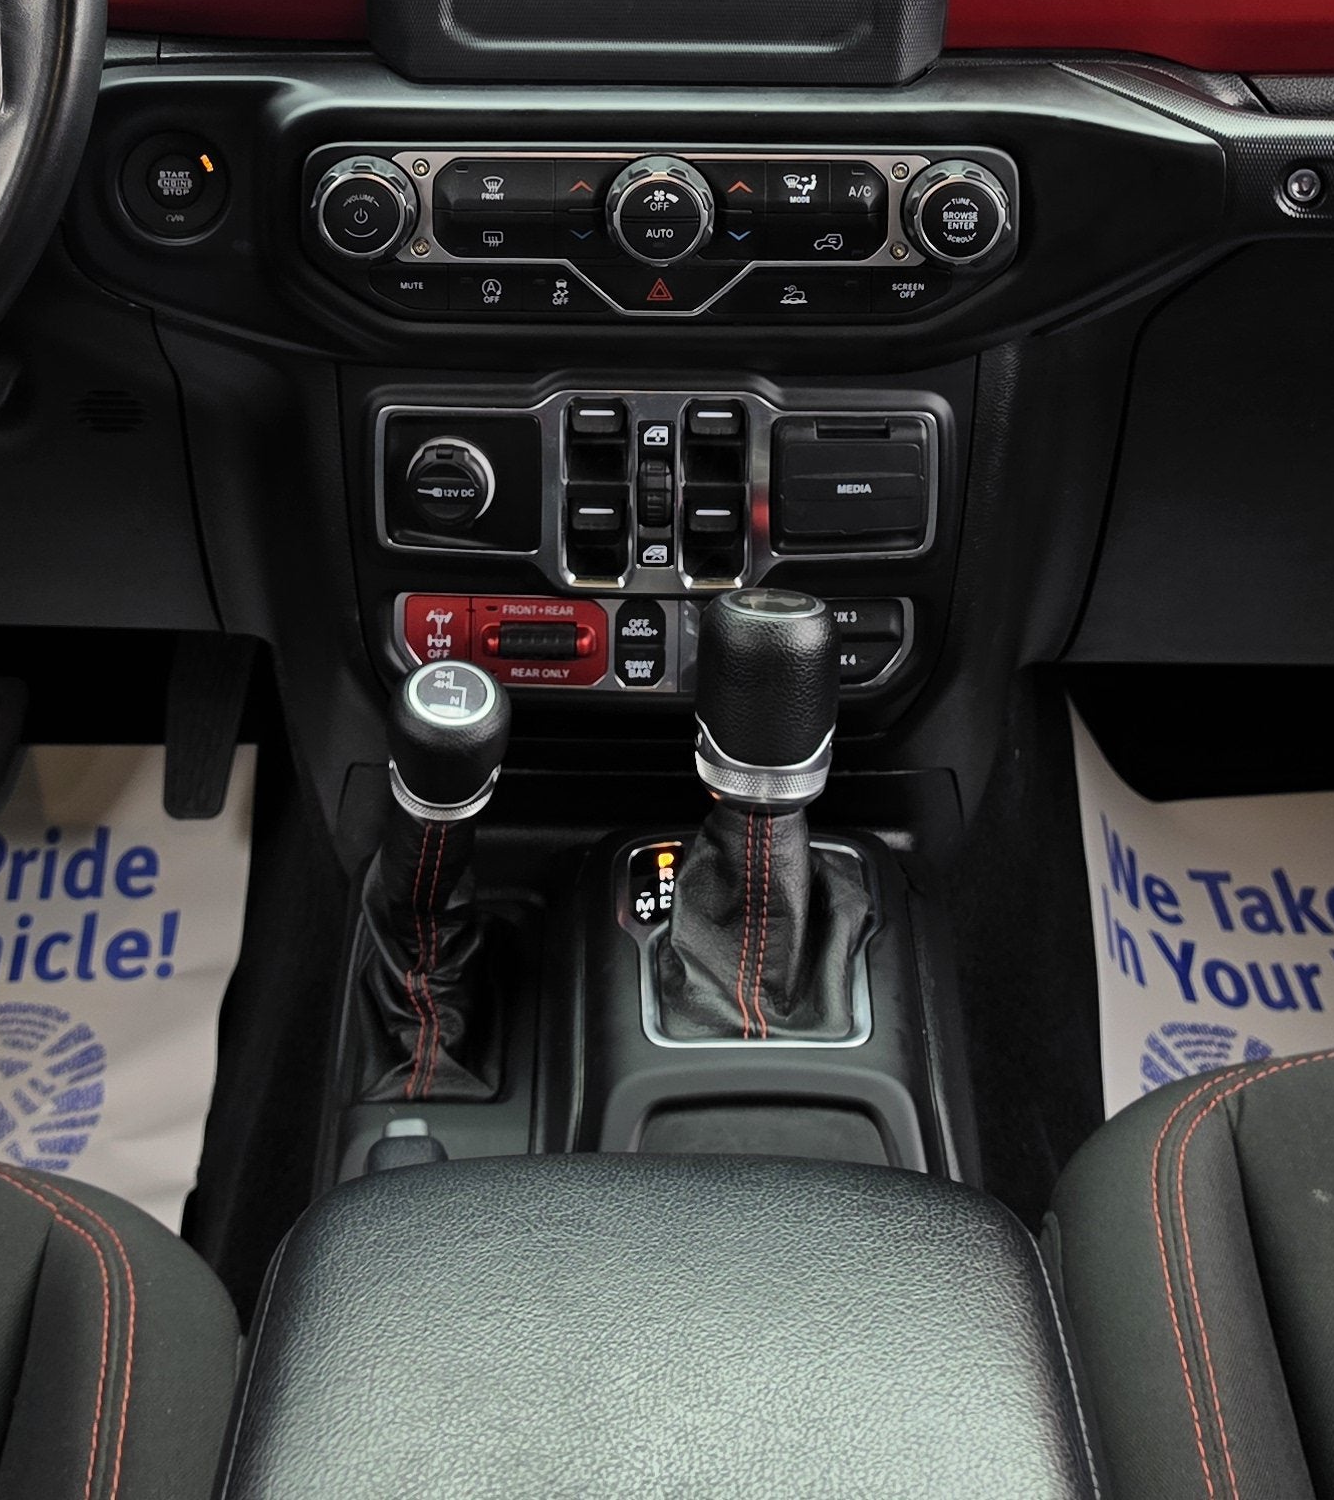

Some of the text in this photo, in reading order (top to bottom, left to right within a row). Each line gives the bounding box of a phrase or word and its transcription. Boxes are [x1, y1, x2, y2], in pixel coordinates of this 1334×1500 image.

[159, 170, 190, 179] START
[162, 188, 190, 196] STOP
[848, 185, 872, 198] A/C
[481, 193, 504, 201] FRONT
[650, 202, 670, 212] OFF
[942, 212, 978, 220] BROWSE
[948, 221, 975, 230] ENTER
[645, 228, 674, 239] AUTO
[946, 234, 974, 244] SCROLL
[400, 282, 424, 290] MUTE
[892, 283, 925, 291] SCREEN
[483, 296, 499, 304] OFF
[900, 291, 916, 299] OFF
[552, 297, 569, 306] OFF
[460, 488, 475, 498] DC
[837, 483, 872, 494] MEDIA
[850, 611, 858, 622] 3
[628, 618, 649, 628] OFF
[427, 649, 450, 659] OFF
[848, 654, 857, 665] 4
[625, 660, 654, 670] SWAY
[510, 668, 570, 679] REAR ONLY
[628, 669, 651, 679] BAR
[432, 680, 450, 689] 4H
[450, 696, 459, 705] N
[658, 853, 674, 868] P
[1100, 810, 1183, 927] We
[659, 868, 674, 881] R
[660, 881, 674, 894] N
[636, 897, 655, 912] M
[1102, 883, 1147, 988] In
[1149, 929, 1323, 1013] Your
